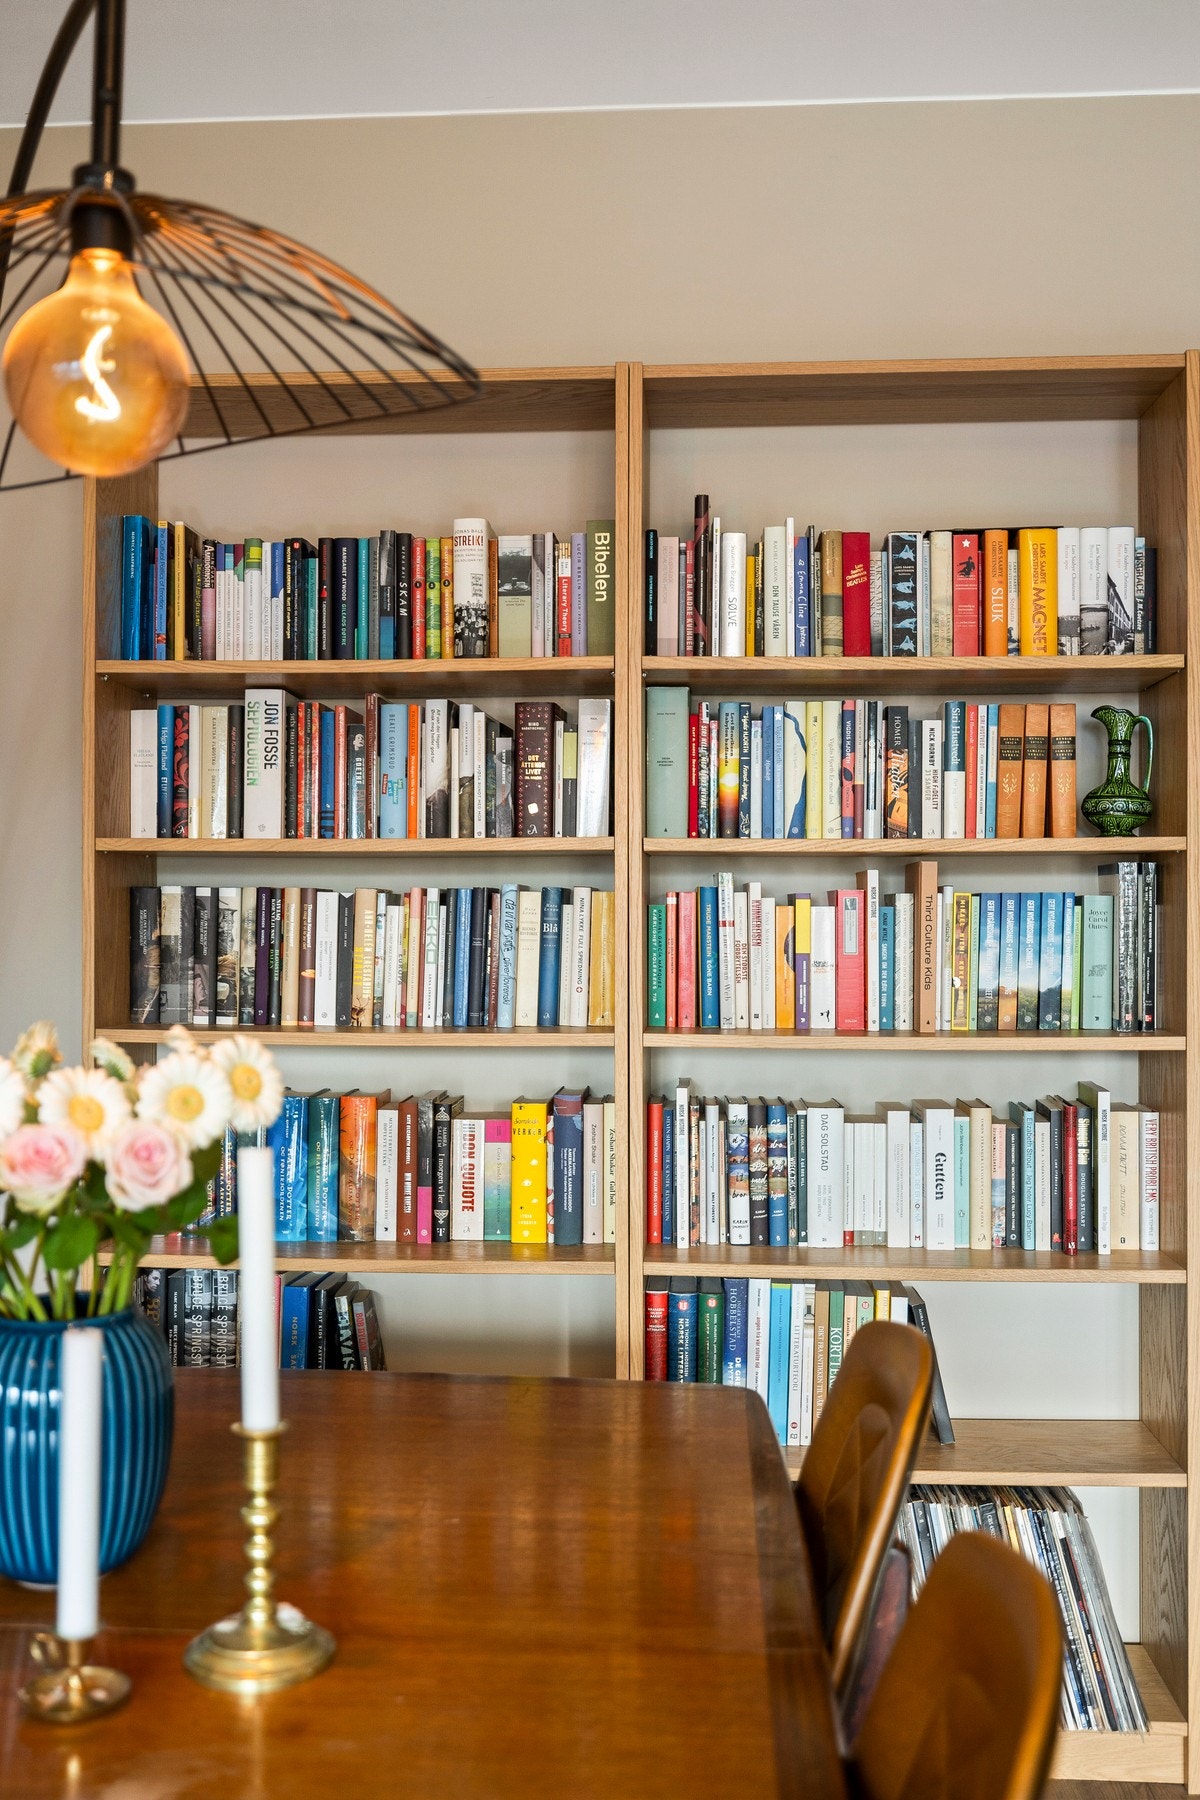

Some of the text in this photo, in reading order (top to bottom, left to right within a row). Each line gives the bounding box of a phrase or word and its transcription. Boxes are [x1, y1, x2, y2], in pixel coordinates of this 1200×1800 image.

[454, 535, 484, 547] STREIK!
[594, 532, 610, 602] Bibelen
[1135, 552, 1144, 594] DISGRACE
[400, 582, 408, 616] SKAM
[728, 597, 738, 627] SØLVE
[797, 570, 806, 618] Emma Cline
[991, 587, 1004, 623] SLUK
[1032, 587, 1047, 653] MAGNET
[246, 701, 260, 786] SEPTOLOGIEN
[264, 700, 279, 770] JON FOSSE
[951, 707, 960, 765] Siri Hustvedt
[891, 752, 904, 799] Iliaden
[504, 899, 516, 932] da vi var
[986, 900, 995, 911] GERT
[1006, 899, 1014, 911] GERT
[426, 900, 438, 964] EKKO
[542, 923, 558, 933] Blå
[925, 894, 933, 990] Third Culture Kids
[279, 1146, 286, 1156] OG
[512, 1128, 542, 1136] VERKER
[752, 1143, 766, 1153] dro
[770, 1140, 784, 1149] dro
[820, 1114, 828, 1171] DAG SOLSTAD
[1076, 1118, 1090, 1147] Shuggie
[460, 1133, 475, 1212] DON QUIJOTE
[934, 1152, 946, 1200] Gutten
[1078, 1148, 1090, 1165] Bain
[1145, 1118, 1157, 1202] VERY BRITISH PROBLEMS
[191, 1276, 203, 1366] BRUCE SPRINGST
[216, 1277, 228, 1366] BRUCE SPRINGST
[356, 1312, 364, 1327] BOB
[729, 1288, 737, 1351] HOBBELSTAD
[358, 1327, 368, 1352] DYLAN
[735, 1357, 742, 1368] DE
